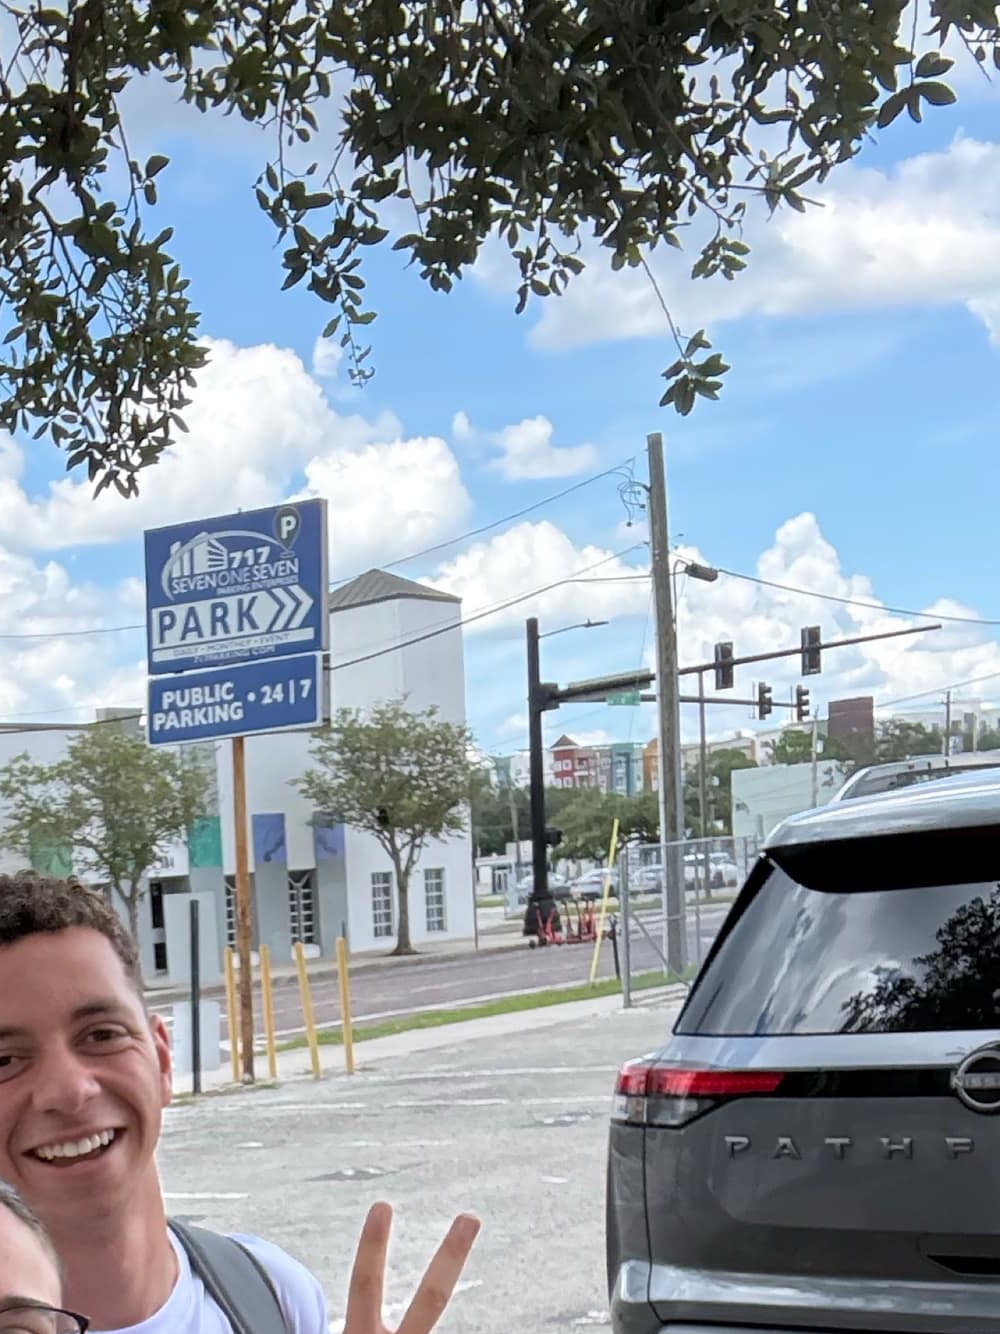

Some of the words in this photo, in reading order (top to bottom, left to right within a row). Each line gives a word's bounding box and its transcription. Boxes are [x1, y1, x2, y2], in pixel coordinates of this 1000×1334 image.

[229, 546, 271, 569] 717
[158, 595, 259, 645] PARK
[161, 682, 235, 709] PUBLIC
[153, 702, 244, 731] PARKING
[724, 1136, 975, 1161] PATHF
